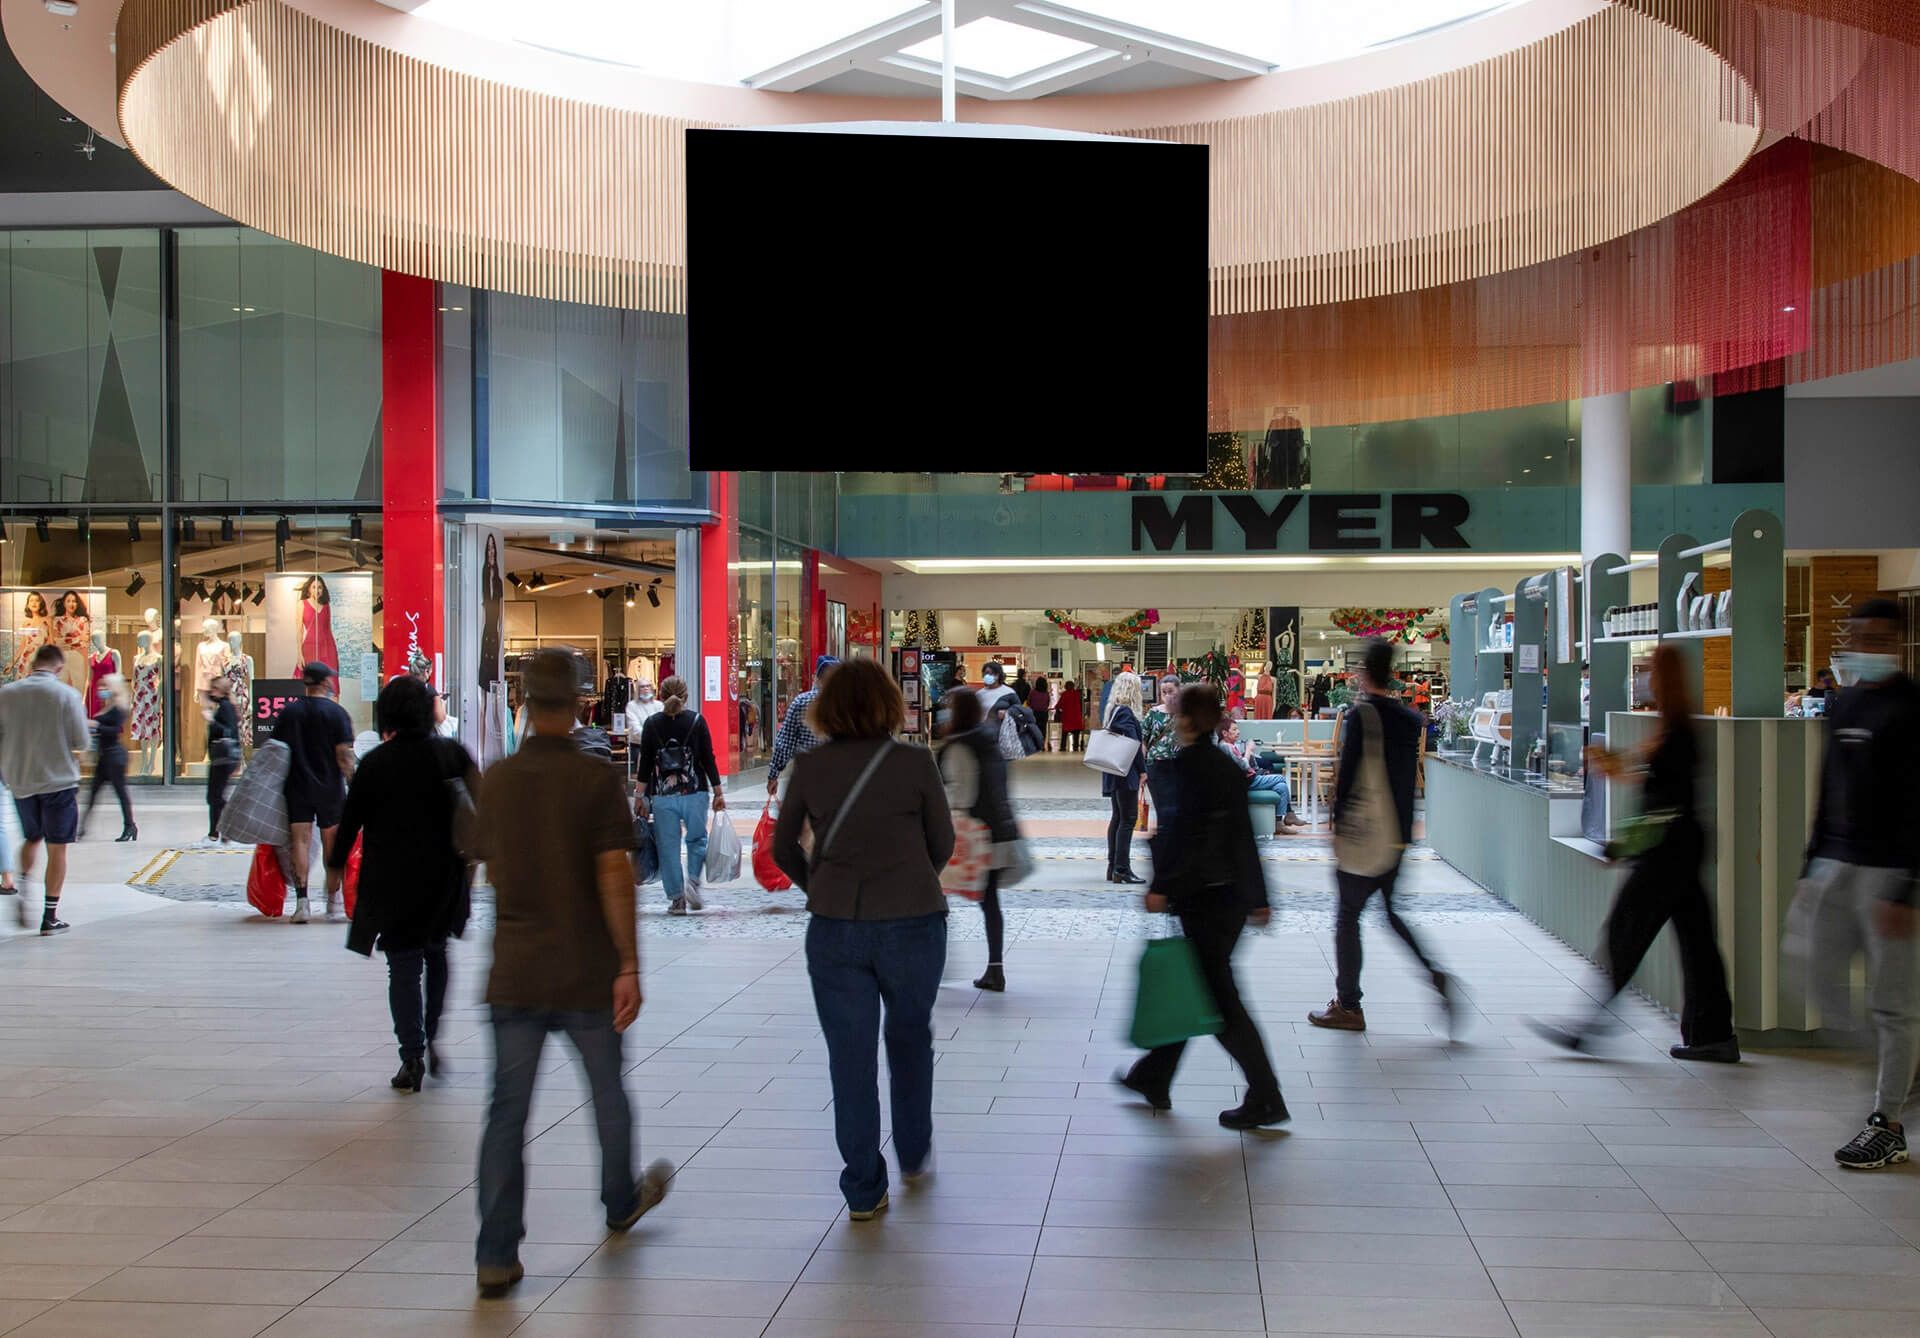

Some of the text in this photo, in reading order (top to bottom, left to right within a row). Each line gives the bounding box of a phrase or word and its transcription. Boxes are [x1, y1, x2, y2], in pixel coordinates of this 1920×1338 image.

[1132, 493, 1472, 551] MYER
[1831, 593, 1852, 656] kki.K
[921, 652, 936, 661] ior
